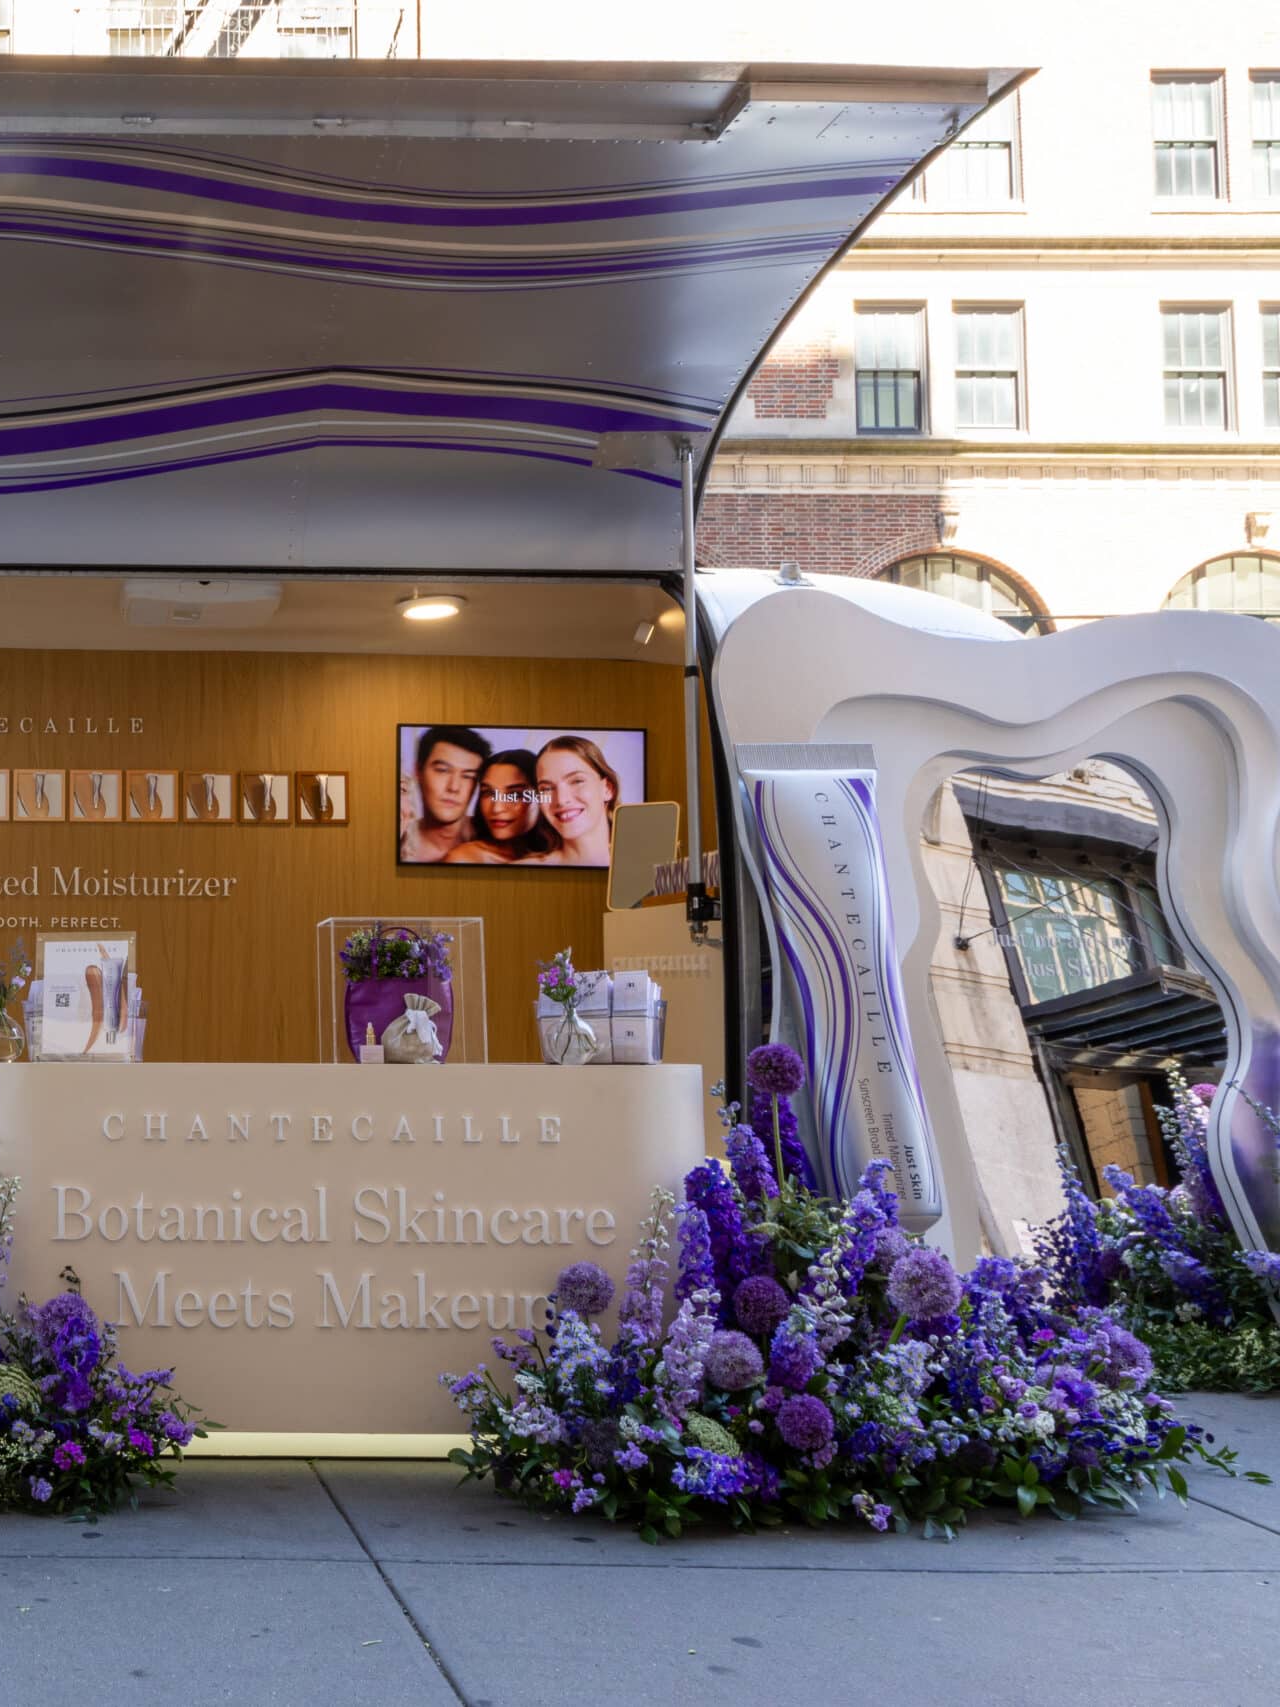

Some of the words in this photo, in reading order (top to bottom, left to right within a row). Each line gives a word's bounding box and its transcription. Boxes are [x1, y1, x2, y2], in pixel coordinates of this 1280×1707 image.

[491, 789, 518, 803] Just
[522, 789, 552, 804] Skin
[52, 866, 237, 897] Moisturizer
[51, 917, 121, 928] PERFECT.
[814, 791, 893, 1073] CHANTECAILLE
[101, 1111, 562, 1143] CHANTECAILLE
[858, 1078, 875, 1125] Sunscreen
[868, 1127, 884, 1155] Broad
[883, 1113, 896, 1142] Tinted
[904, 1145, 917, 1169] Just
[889, 1145, 907, 1201] Moisturizer
[910, 1173, 923, 1200] Skin
[49, 1184, 333, 1243] Botanical
[352, 1185, 617, 1245] Skincare
[112, 1270, 297, 1330] Meets
